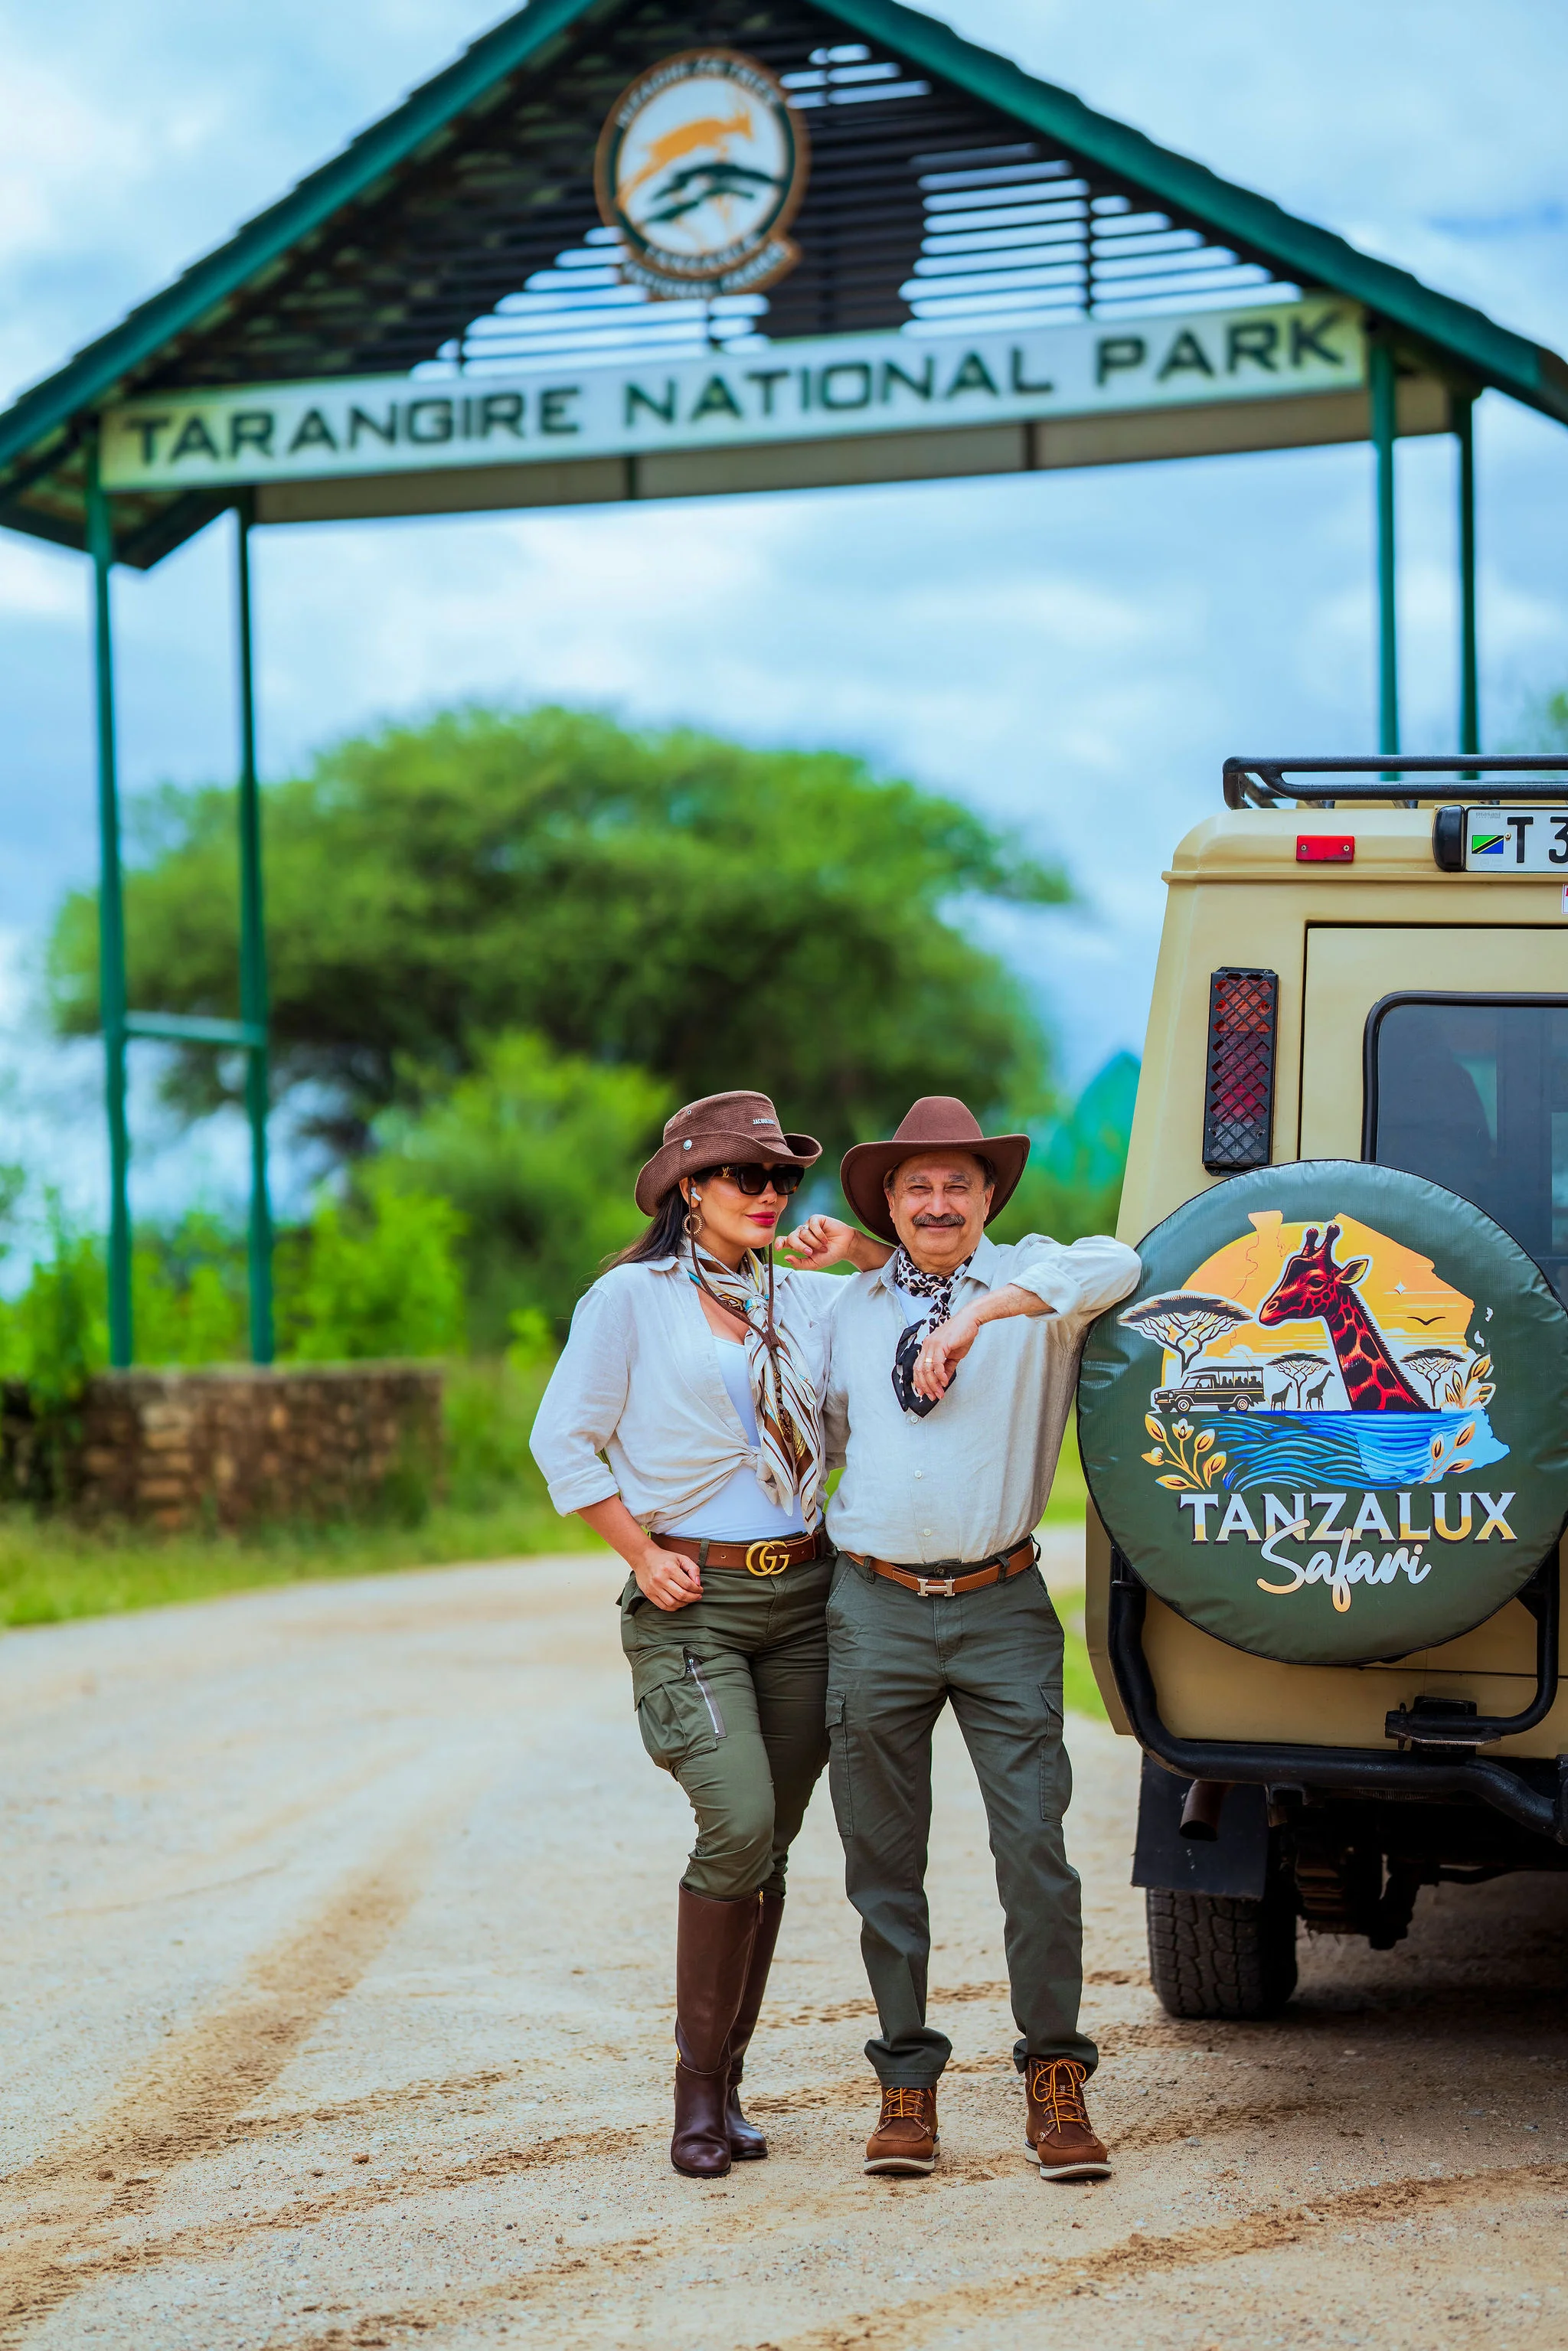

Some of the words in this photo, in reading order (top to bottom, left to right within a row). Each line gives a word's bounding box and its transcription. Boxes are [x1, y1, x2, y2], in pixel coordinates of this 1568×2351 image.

[122, 386, 580, 469] TARANGIRE
[625, 346, 1055, 429] NATIONAL
[1097, 312, 1346, 386] PARK
[1507, 816, 1534, 864] T
[1178, 1492, 1518, 1543] TANZALUX
[1256, 1519, 1432, 1613] Safari
